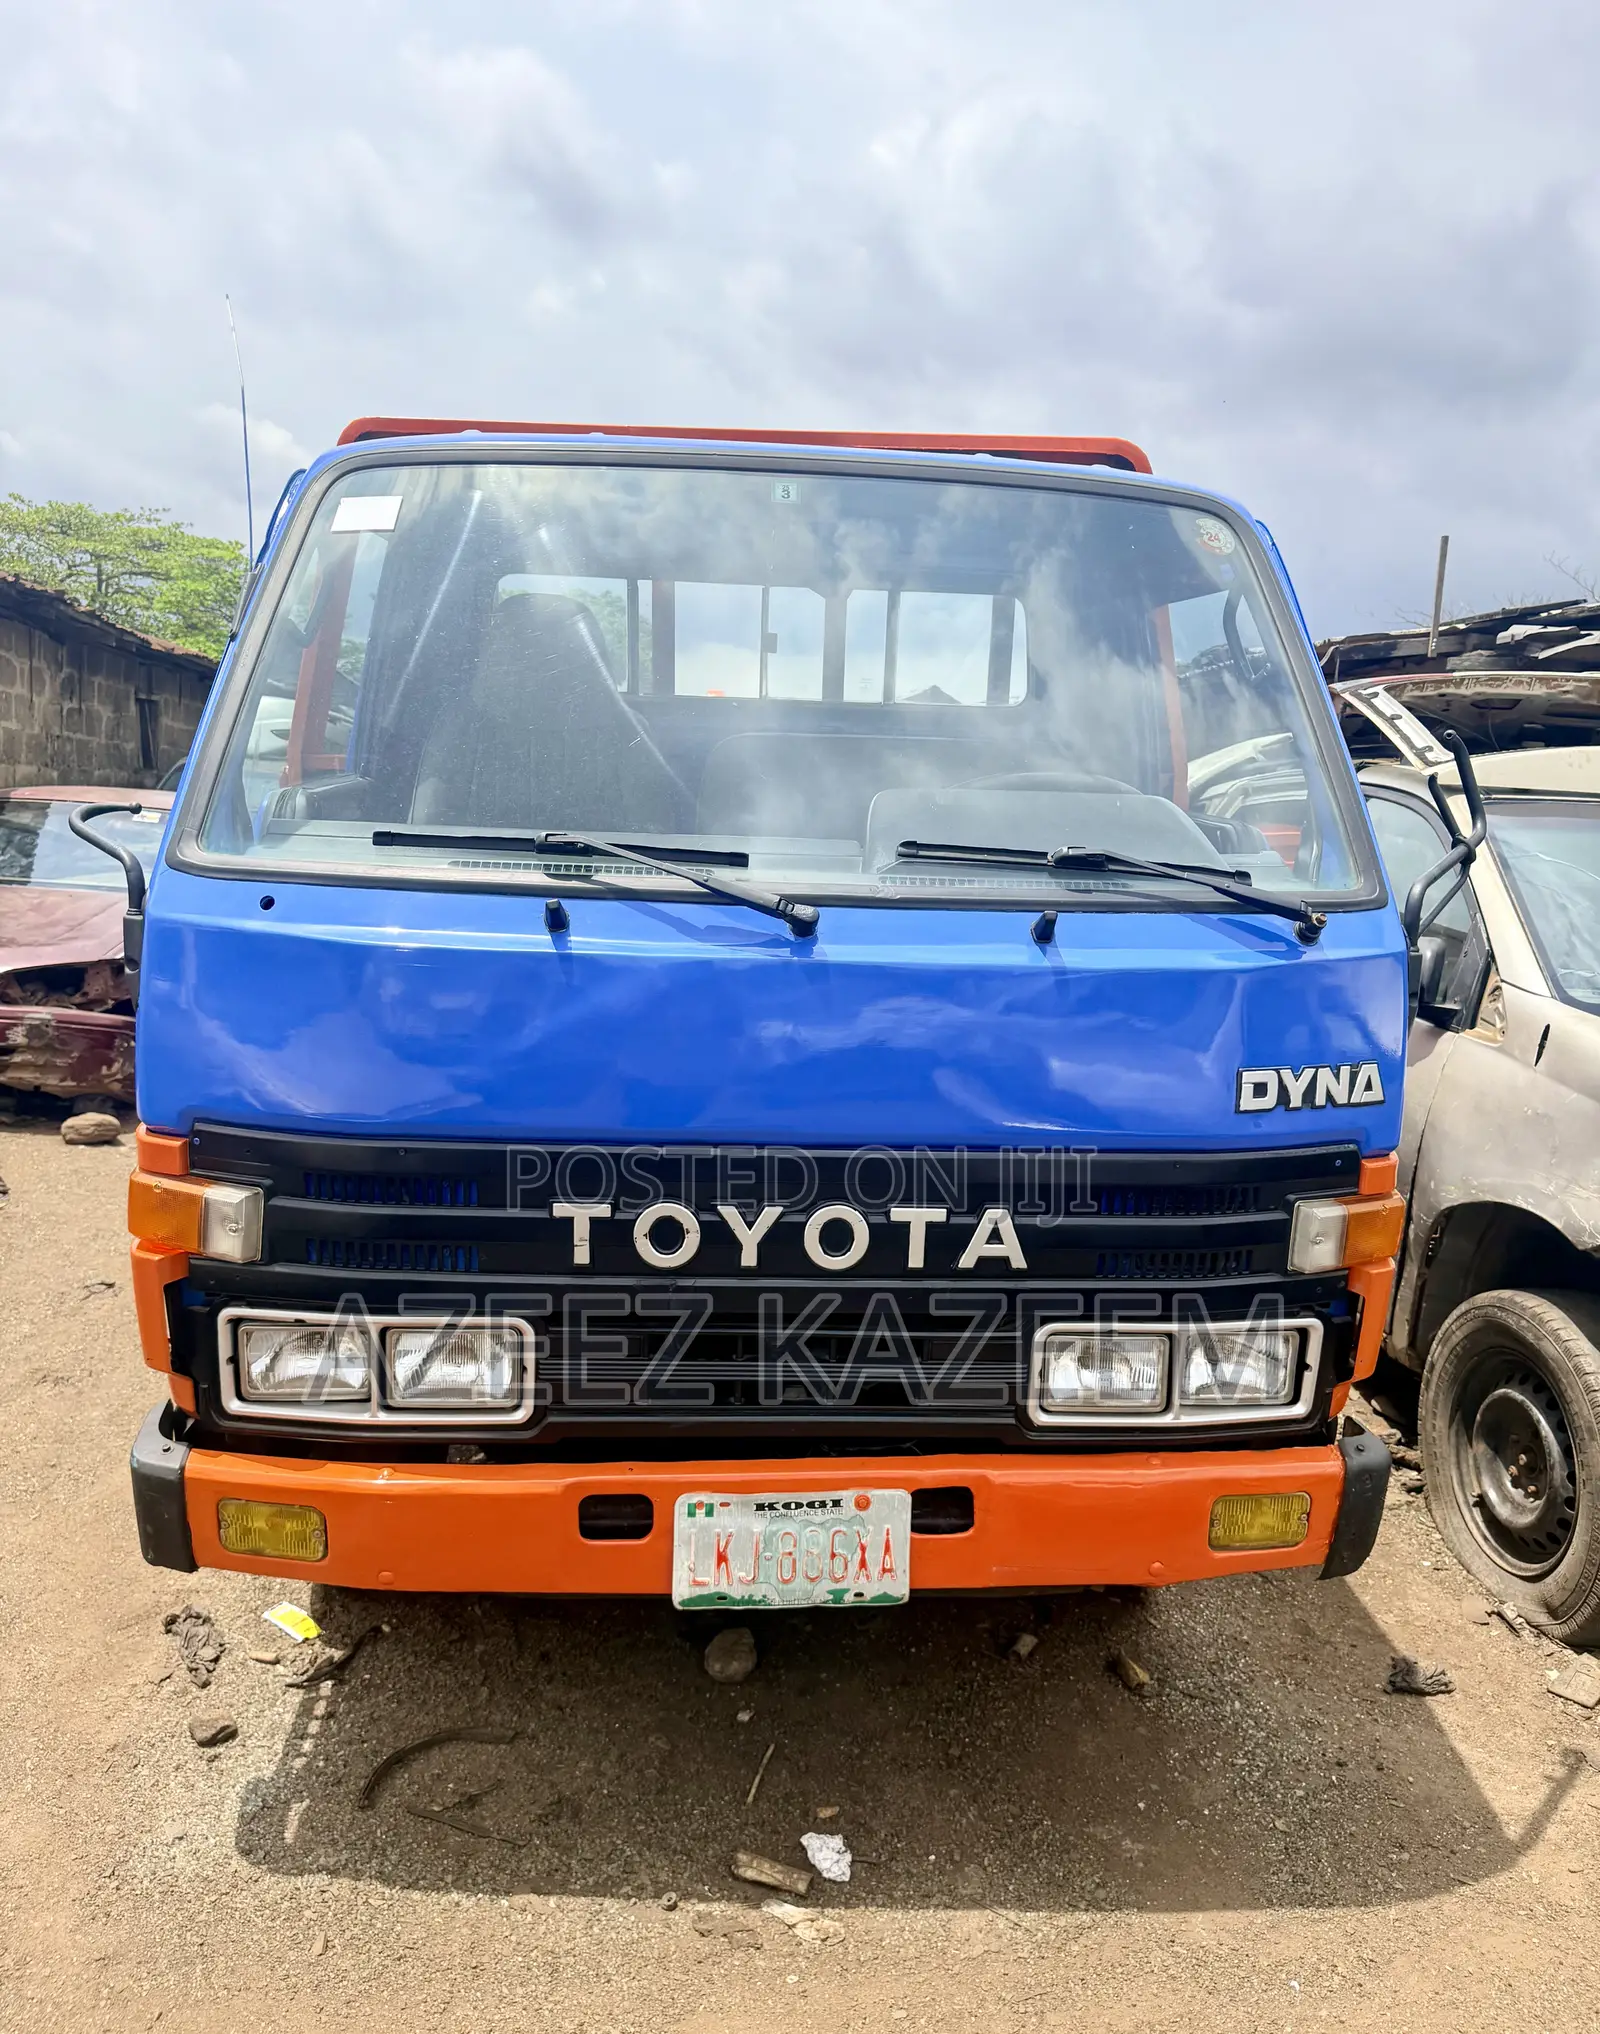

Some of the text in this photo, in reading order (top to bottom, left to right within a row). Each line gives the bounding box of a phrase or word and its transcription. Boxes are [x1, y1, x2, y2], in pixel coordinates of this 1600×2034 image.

[781, 489, 791, 499] 3
[1238, 1062, 1385, 1112] DYNA
[552, 1203, 1028, 1270] TOYOTA
[753, 1498, 844, 1512] KOGI
[769, 1509, 819, 1518] CONFLUENCE
[820, 1508, 843, 1516] STATE
